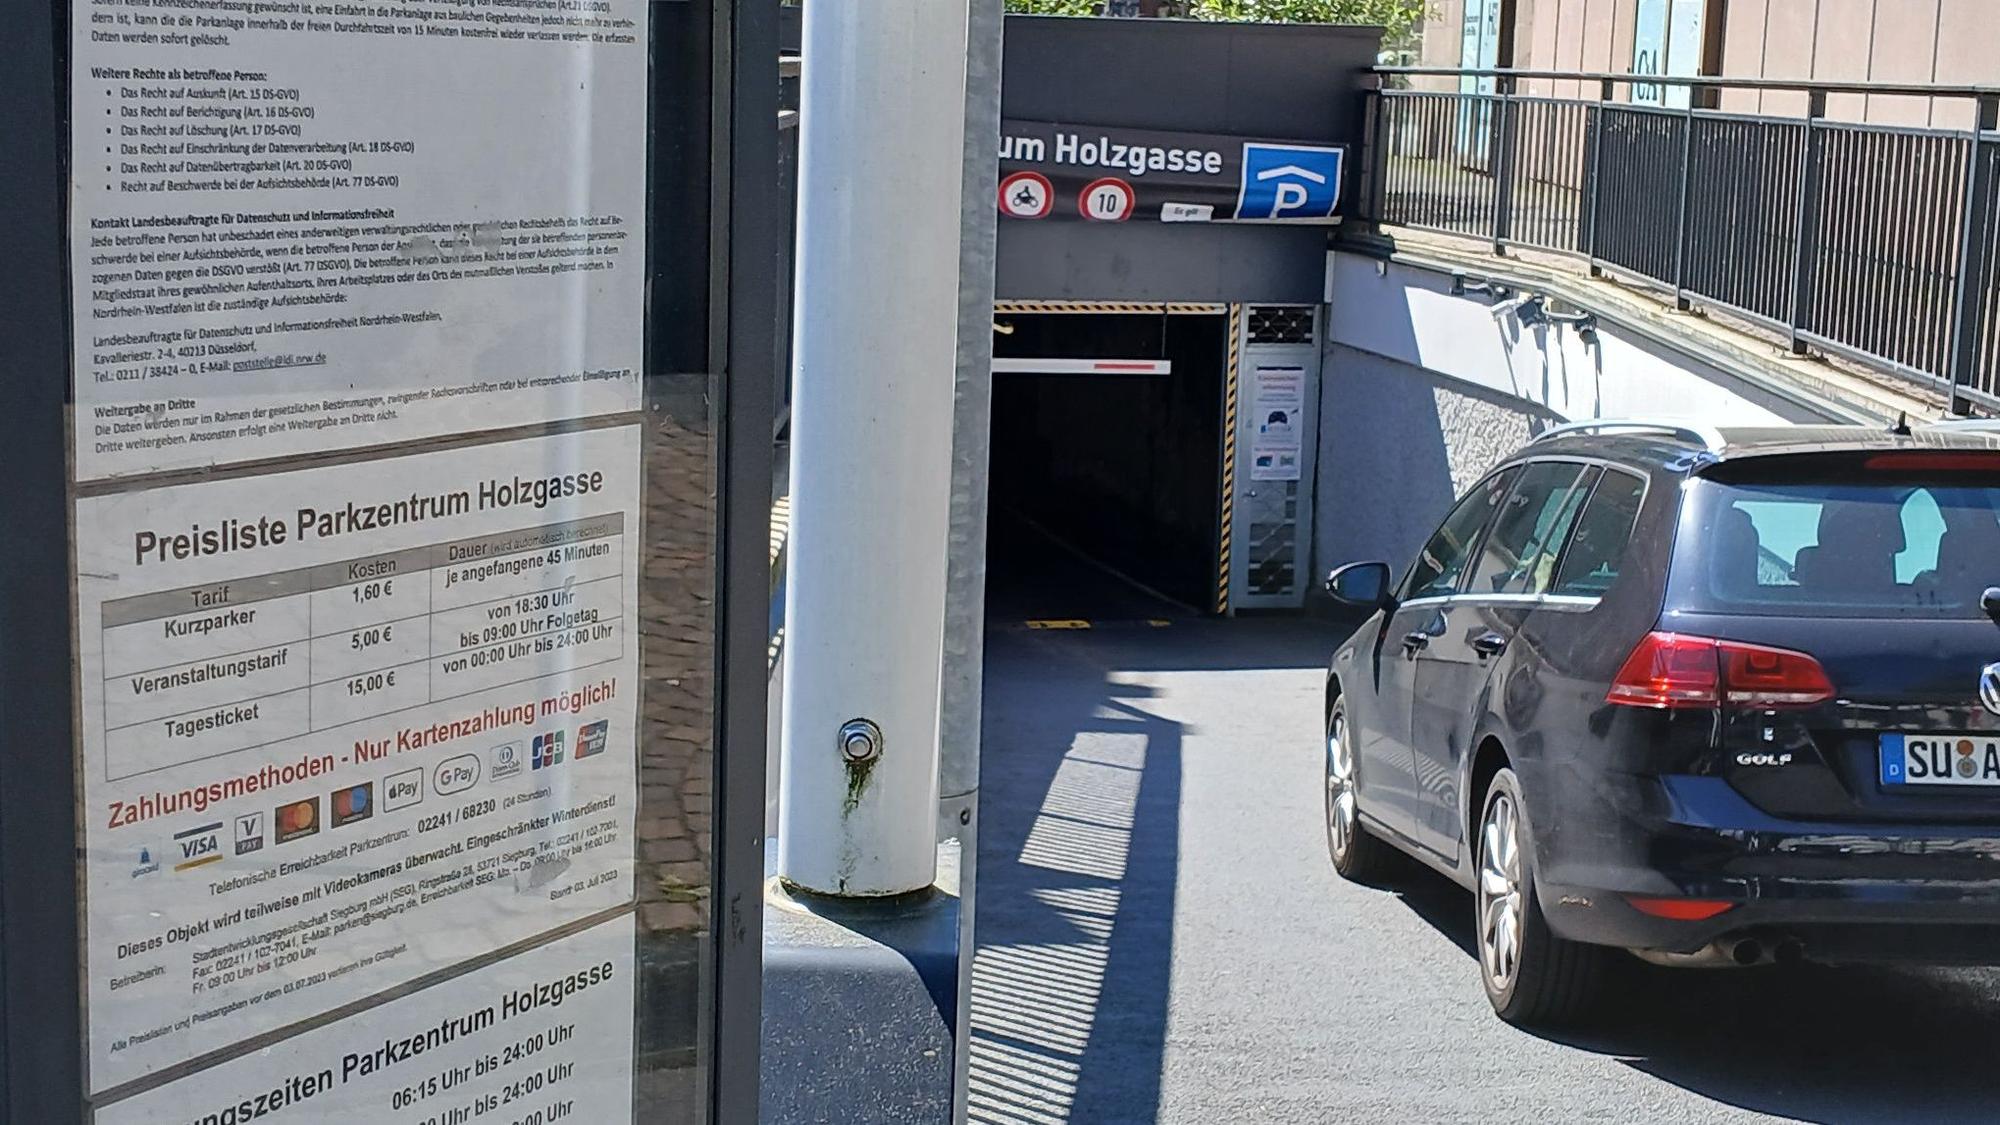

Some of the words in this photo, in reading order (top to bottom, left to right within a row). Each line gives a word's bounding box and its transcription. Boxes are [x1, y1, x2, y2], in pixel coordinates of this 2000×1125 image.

[92, 31, 119, 41] Daten
[122, 32, 158, 43] werden
[161, 32, 187, 44] sofort
[92, 67, 131, 80] Weitere
[133, 68, 166, 80] Rechte
[169, 68, 181, 80] als
[184, 68, 231, 81] betroffene
[234, 70, 267, 81] Person:
[121, 88, 139, 99] Das
[141, 87, 167, 99] Recht
[170, 87, 184, 99] auf
[187, 87, 226, 99] Auskunft
[229, 88, 250, 101] (Art.
[252, 89, 261, 99] 15
[264, 88, 299, 101] DS-GVO)
[121, 107, 139, 118] Das
[141, 106, 167, 118] Recht
[170, 106, 184, 118] auf
[187, 106, 242, 120] Berichtigung
[244, 106, 264, 119] (Art.
[267, 107, 277, 118] 16
[280, 106, 315, 119] DS-GVO)
[121, 126, 139, 136] Das
[141, 125, 167, 136] Recht
[170, 124, 184, 136] auf
[187, 124, 228, 138] Löschung
[230, 125, 250, 138] (Art.
[253, 126, 262, 136] 17
[265, 125, 301, 138] DS-GVO)
[121, 144, 139, 155] Das
[141, 143, 167, 155] Recht
[170, 142, 184, 155] auf
[187, 142, 250, 157] Einschränkung
[253, 142, 266, 154] der
[269, 142, 347, 157] Datenverarbeitung
[349, 142, 367, 155] (Art.
[369, 143, 379, 154] 18
[382, 142, 415, 154] DS-GVO)
[1056, 133, 1222, 175] Holzgasse
[121, 163, 139, 174] Das
[141, 162, 167, 174] Recht
[170, 161, 184, 173] auf
[187, 161, 281, 175] Datenübertragbarkeit
[283, 160, 302, 173] (Art.
[304, 160, 315, 172] 20
[317, 159, 352, 172] DS-GVO)
[121, 181, 147, 193] Recht
[150, 180, 165, 192] auf
[167, 180, 221, 193] Beschwerde
[224, 179, 239, 191] bei
[241, 179, 254, 191] der
[257, 177, 331, 191] Aufsichtsbehörde
[333, 177, 351, 190] (Art.
[353, 177, 362, 188] 77
[364, 176, 399, 189] DS-GVO)
[1100, 193, 1117, 213] 10
[1270, 183, 1307, 219] P
[92, 217, 130, 230] Kontakt
[132, 213, 219, 229] Landesbeauftragte
[221, 212, 234, 225] für
[237, 211, 291, 224] Datenschutz
[293, 209, 309, 222] und
[312, 206, 394, 222] Informationsfreiheit
[94, 302, 193, 320] Nordrhein-Westfalen
[194, 301, 206, 313] ist
[208, 300, 221, 312] die
[223, 296, 269, 312] zuständige
[95, 402, 151, 420] Weitergabe
[153, 403, 166, 413] an
[168, 399, 196, 412] Dritte
[135, 515, 288, 566] Preisliste
[297, 488, 471, 541] Parkzentrum
[479, 470, 603, 511] Holzgasse
[445, 566, 459, 588] je
[461, 554, 544, 583] angefangene
[547, 551, 561, 569] 45
[564, 540, 610, 562] Minuten
[448, 541, 488, 562] Dauer
[348, 559, 397, 581] Kosten
[164, 610, 257, 639] Kurzparker
[352, 581, 381, 605] 1,60
[383, 580, 393, 598] €
[191, 586, 230, 607] Tarif
[488, 604, 512, 621] von
[515, 594, 549, 616] 18:30
[552, 588, 575, 607] Uhr
[460, 630, 480, 648] bis
[483, 622, 518, 645] 09:00
[520, 615, 545, 635] Uhr
[547, 606, 599, 632] Folgetag
[131, 648, 288, 696] Veranstaltungstarif
[351, 628, 381, 651] 5,00
[383, 625, 393, 643] €
[443, 658, 468, 675] von
[471, 647, 506, 669] 00:00
[508, 640, 532, 661] Uhr
[534, 634, 553, 655] bis
[556, 628, 590, 650] 24:00
[592, 622, 614, 642] Uhr
[165, 703, 260, 739] Tagesticket
[346, 675, 383, 699] 15,00
[386, 671, 396, 688] €
[108, 753, 335, 829] Zahlungsmethoden
[354, 738, 392, 765] Nur
[396, 702, 536, 754] Kartenzahlung
[541, 677, 617, 718] möglich!
[1737, 752, 1793, 767] GOLF
[1907, 740, 1953, 779] SU
[453, 759, 476, 785] Pay
[396, 781, 419, 801] Pay
[181, 834, 219, 859] VISA
[209, 867, 277, 896] Telefonische
[279, 845, 349, 876] Erreichbarkeit
[417, 812, 453, 834] 02241
[462, 798, 497, 822] 68230
[117, 934, 164, 960] Dieses
[166, 918, 211, 946] Objekt
[213, 908, 242, 932] wird
[244, 894, 300, 922] teilweise
[302, 886, 323, 904] mit
[324, 861, 403, 897] Videokameras
[404, 842, 465, 872] überwacht.
[466, 815, 551, 851] Eingeschränkter
[551, 794, 617, 829] Winterdienst!
[192, 911, 328, 964] Stadtentwicklungsgesellschaft
[330, 898, 368, 922] Siegburg
[238, 966, 256, 981] Uhr
[257, 960, 272, 977] bis
[301, 945, 318, 960] Uhr
[341, 1007, 495, 1084] Parkzentrum
[502, 961, 614, 1021] Holzgasse
[392, 1076, 438, 1111] 06:15
[441, 1065, 472, 1092] Uhr
[475, 1053, 499, 1078] bis
[503, 1033, 544, 1066] 24:00
[547, 1023, 576, 1047] Uhr
[441, 1103, 472, 1125] Uhr
[475, 1092, 499, 1117] bis
[503, 1072, 543, 1105] 24:00
[547, 1062, 575, 1085] Uhr
[547, 1100, 575, 1124] Uhr
